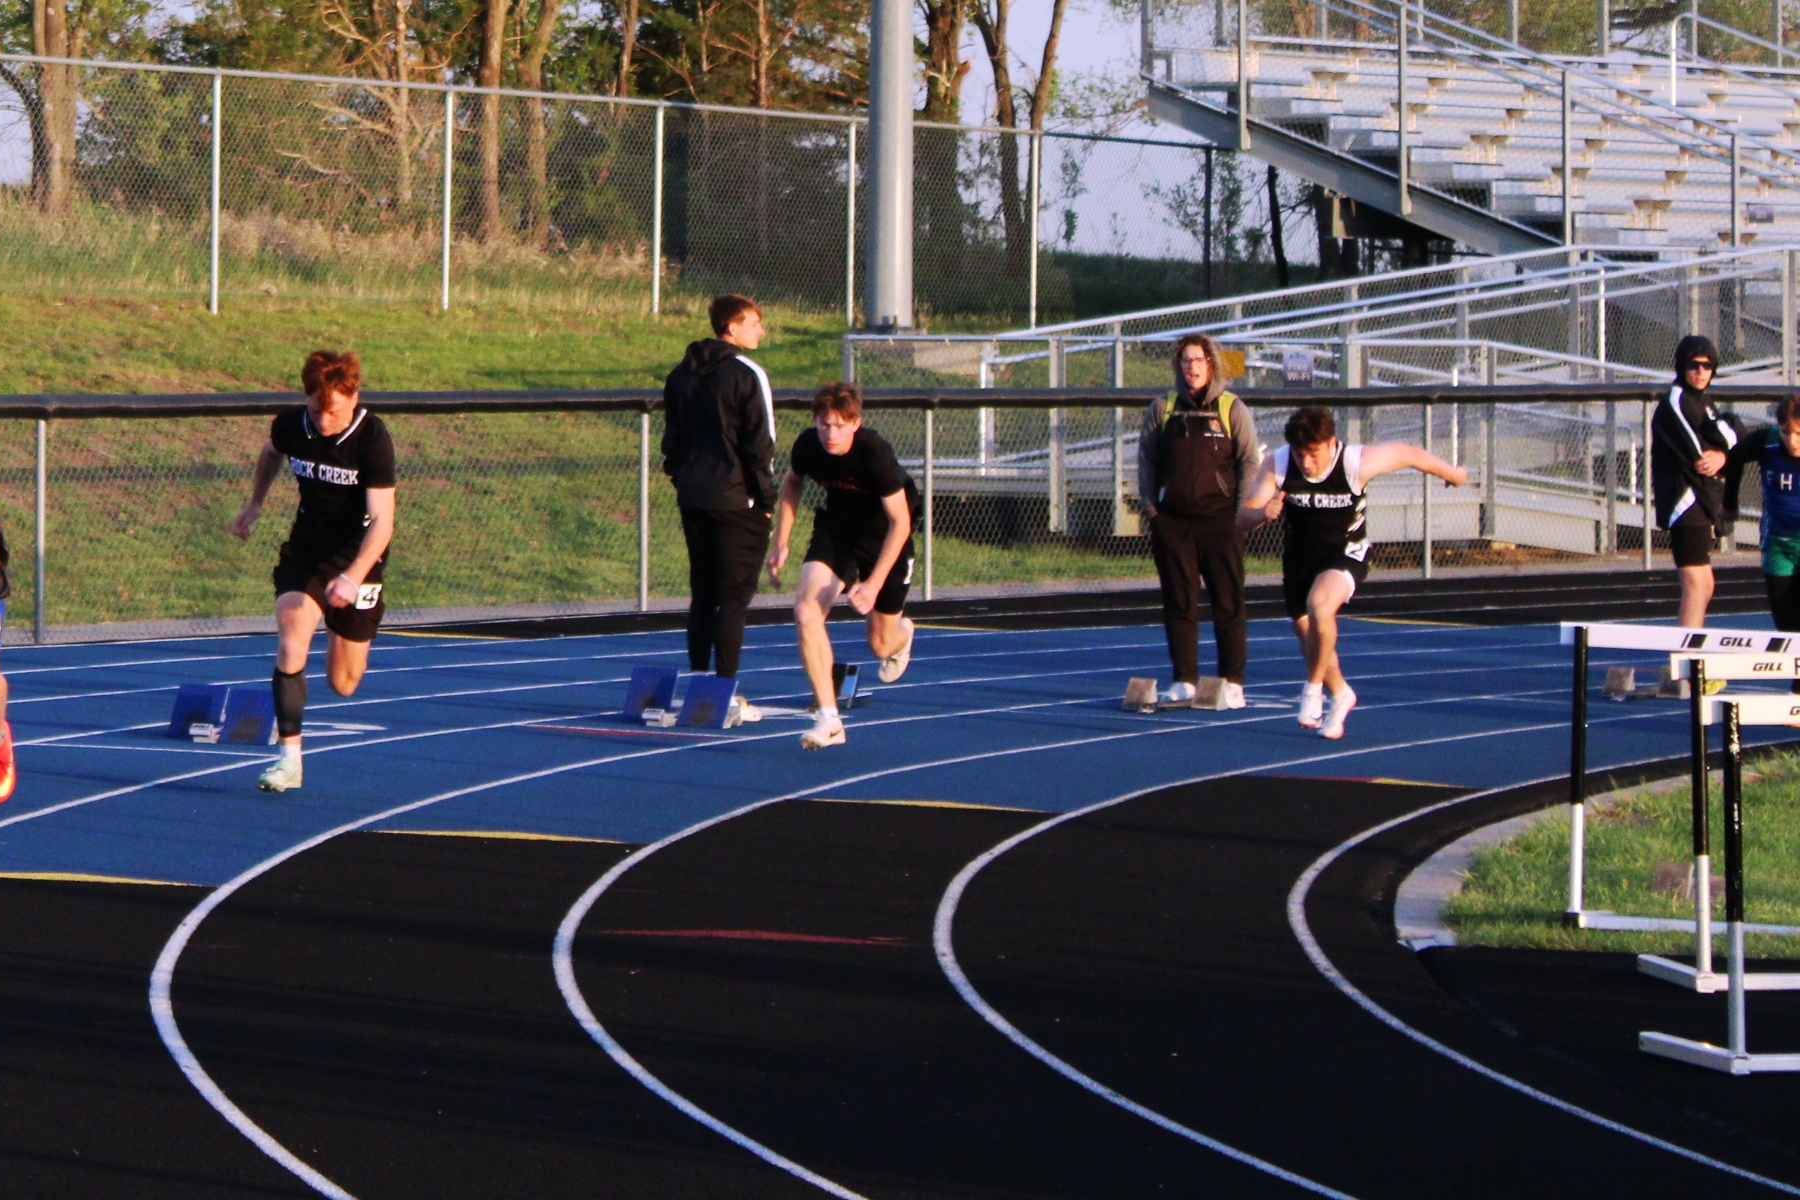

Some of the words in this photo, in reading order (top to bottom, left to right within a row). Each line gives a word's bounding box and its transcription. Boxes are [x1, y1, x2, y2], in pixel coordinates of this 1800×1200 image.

[1287, 371, 1310, 381] Wi-Fi
[319, 463, 359, 486] CREEK
[1288, 493, 1311, 508] OCK
[1314, 492, 1353, 509] CREEK
[1349, 543, 1364, 558] 2
[363, 586, 379, 606] 4
[1719, 636, 1754, 648] GILL
[1752, 662, 1783, 672] GILL
